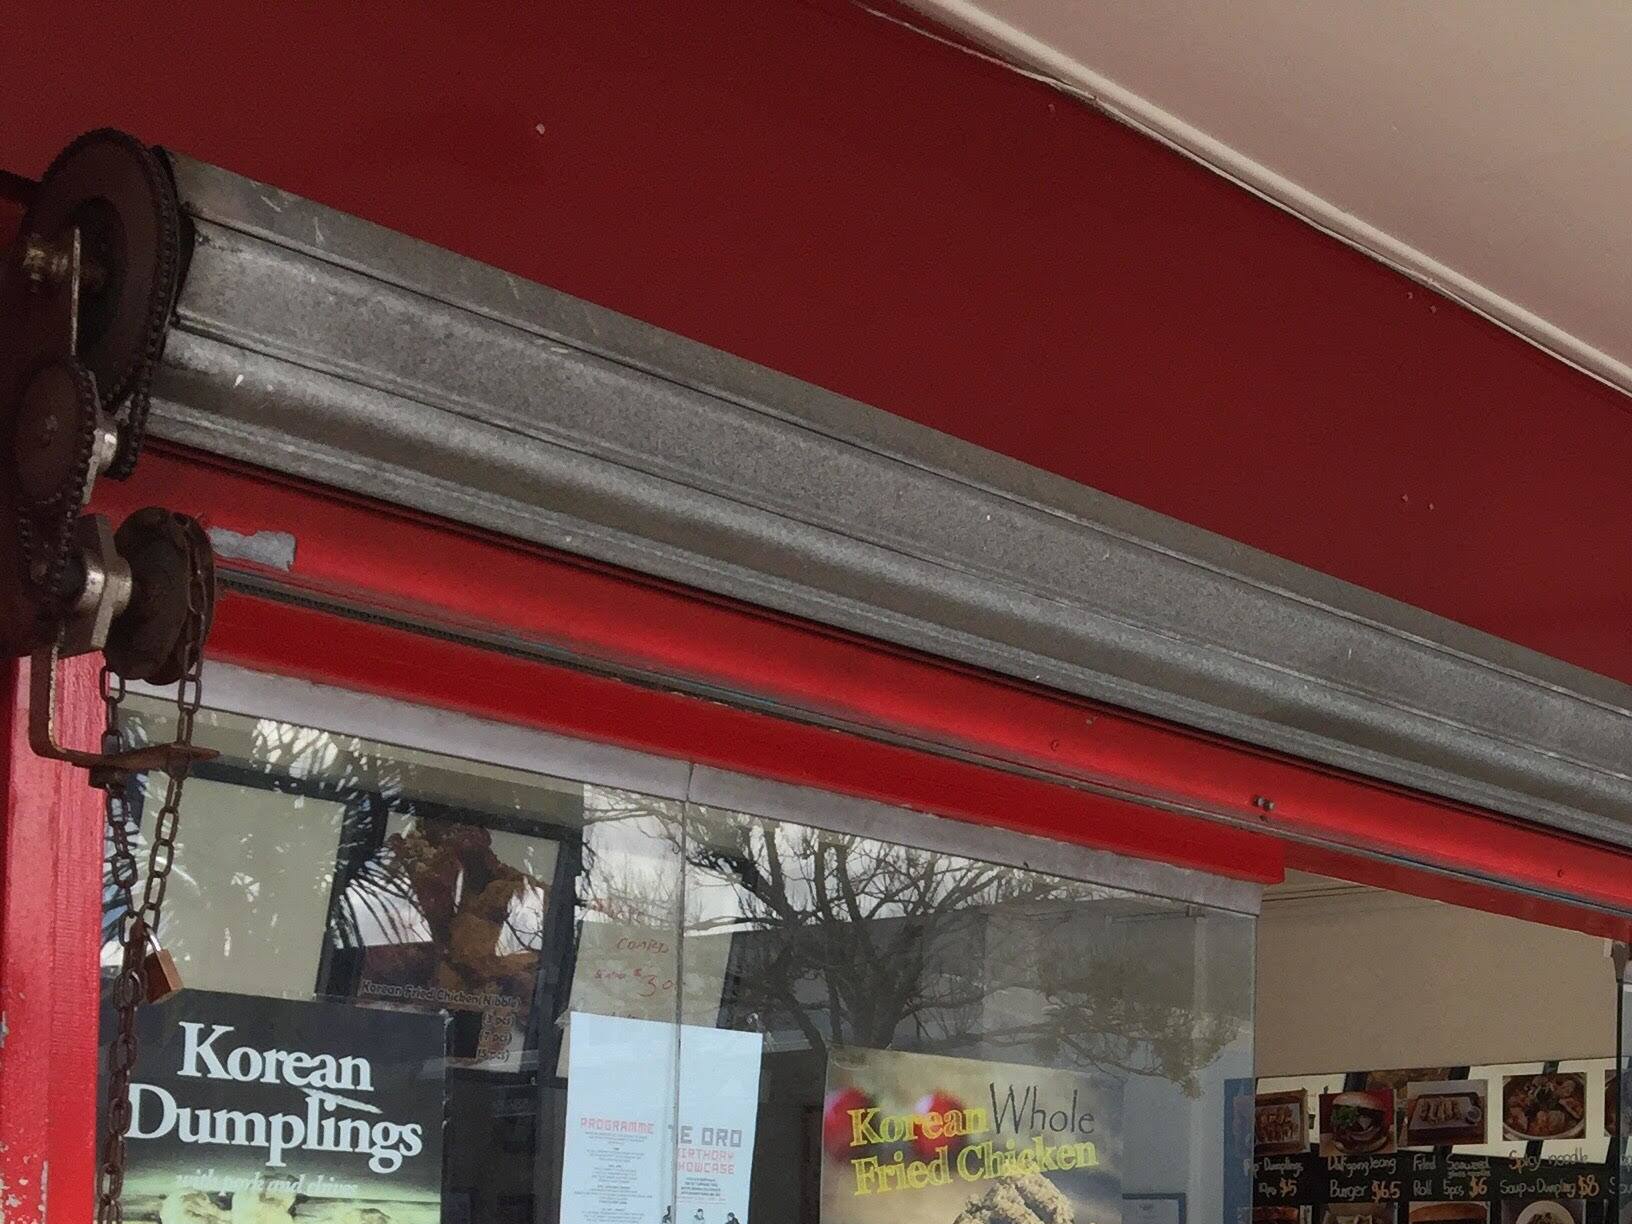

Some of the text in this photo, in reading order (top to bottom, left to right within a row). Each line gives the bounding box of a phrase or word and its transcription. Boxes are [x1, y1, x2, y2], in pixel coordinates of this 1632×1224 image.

[176, 1020, 375, 1093] Korean
[580, 1117, 655, 1135] PROGRAMME
[847, 1082, 1096, 1148] Korean Whole
[124, 1082, 422, 1175] Dumplings
[677, 1147, 735, 1162] IRTHDAY
[851, 1135, 1100, 1197] Fried Chicken
[677, 1160, 735, 1175] HOWCASE
[1330, 1179, 1368, 1202] Burger
[1500, 1179, 1527, 1198] Soup
